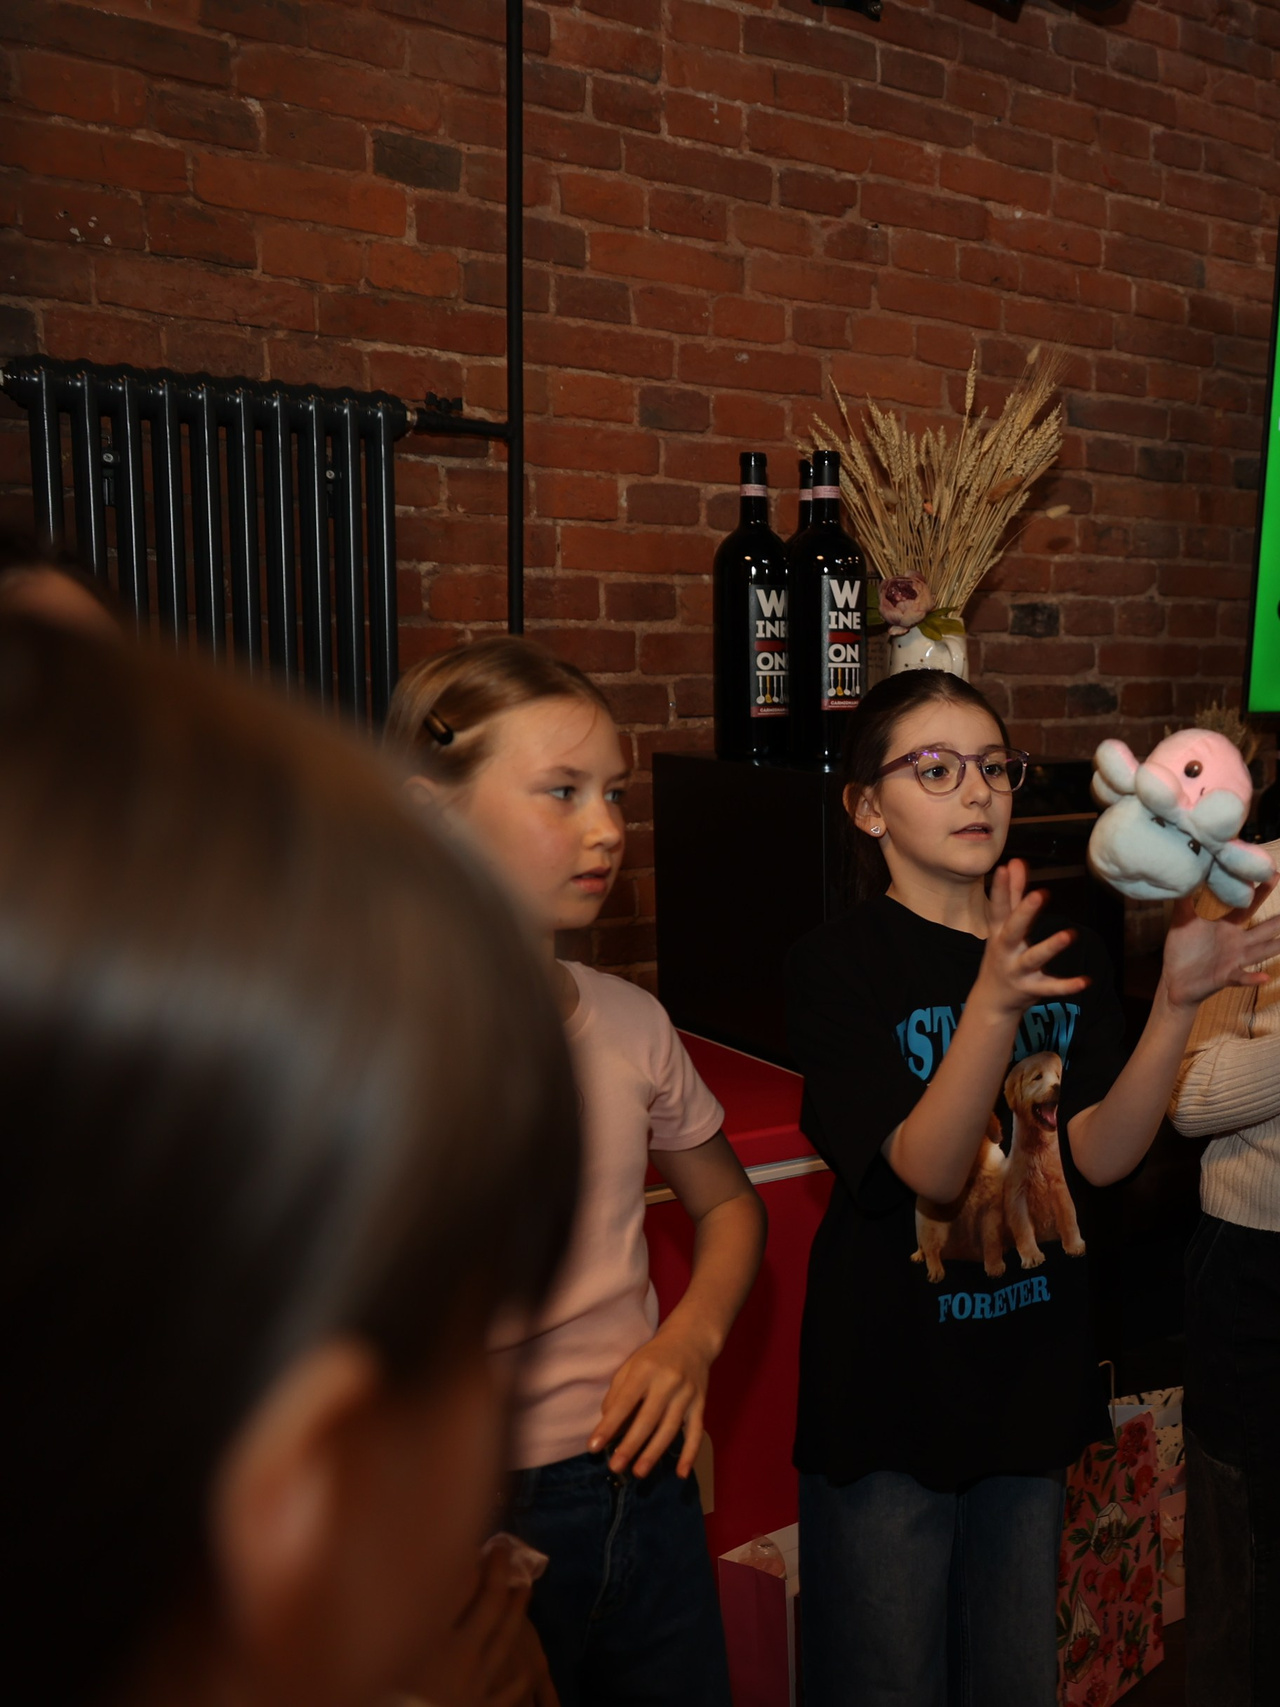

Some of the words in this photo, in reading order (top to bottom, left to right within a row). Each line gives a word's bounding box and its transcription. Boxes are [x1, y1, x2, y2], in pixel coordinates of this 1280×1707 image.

[756, 589, 786, 617] W
[829, 580, 861, 609] W
[828, 611, 861, 629] INE
[756, 652, 787, 671] ON
[828, 643, 860, 663] ON
[938, 1275, 1051, 1323] FOREVER
